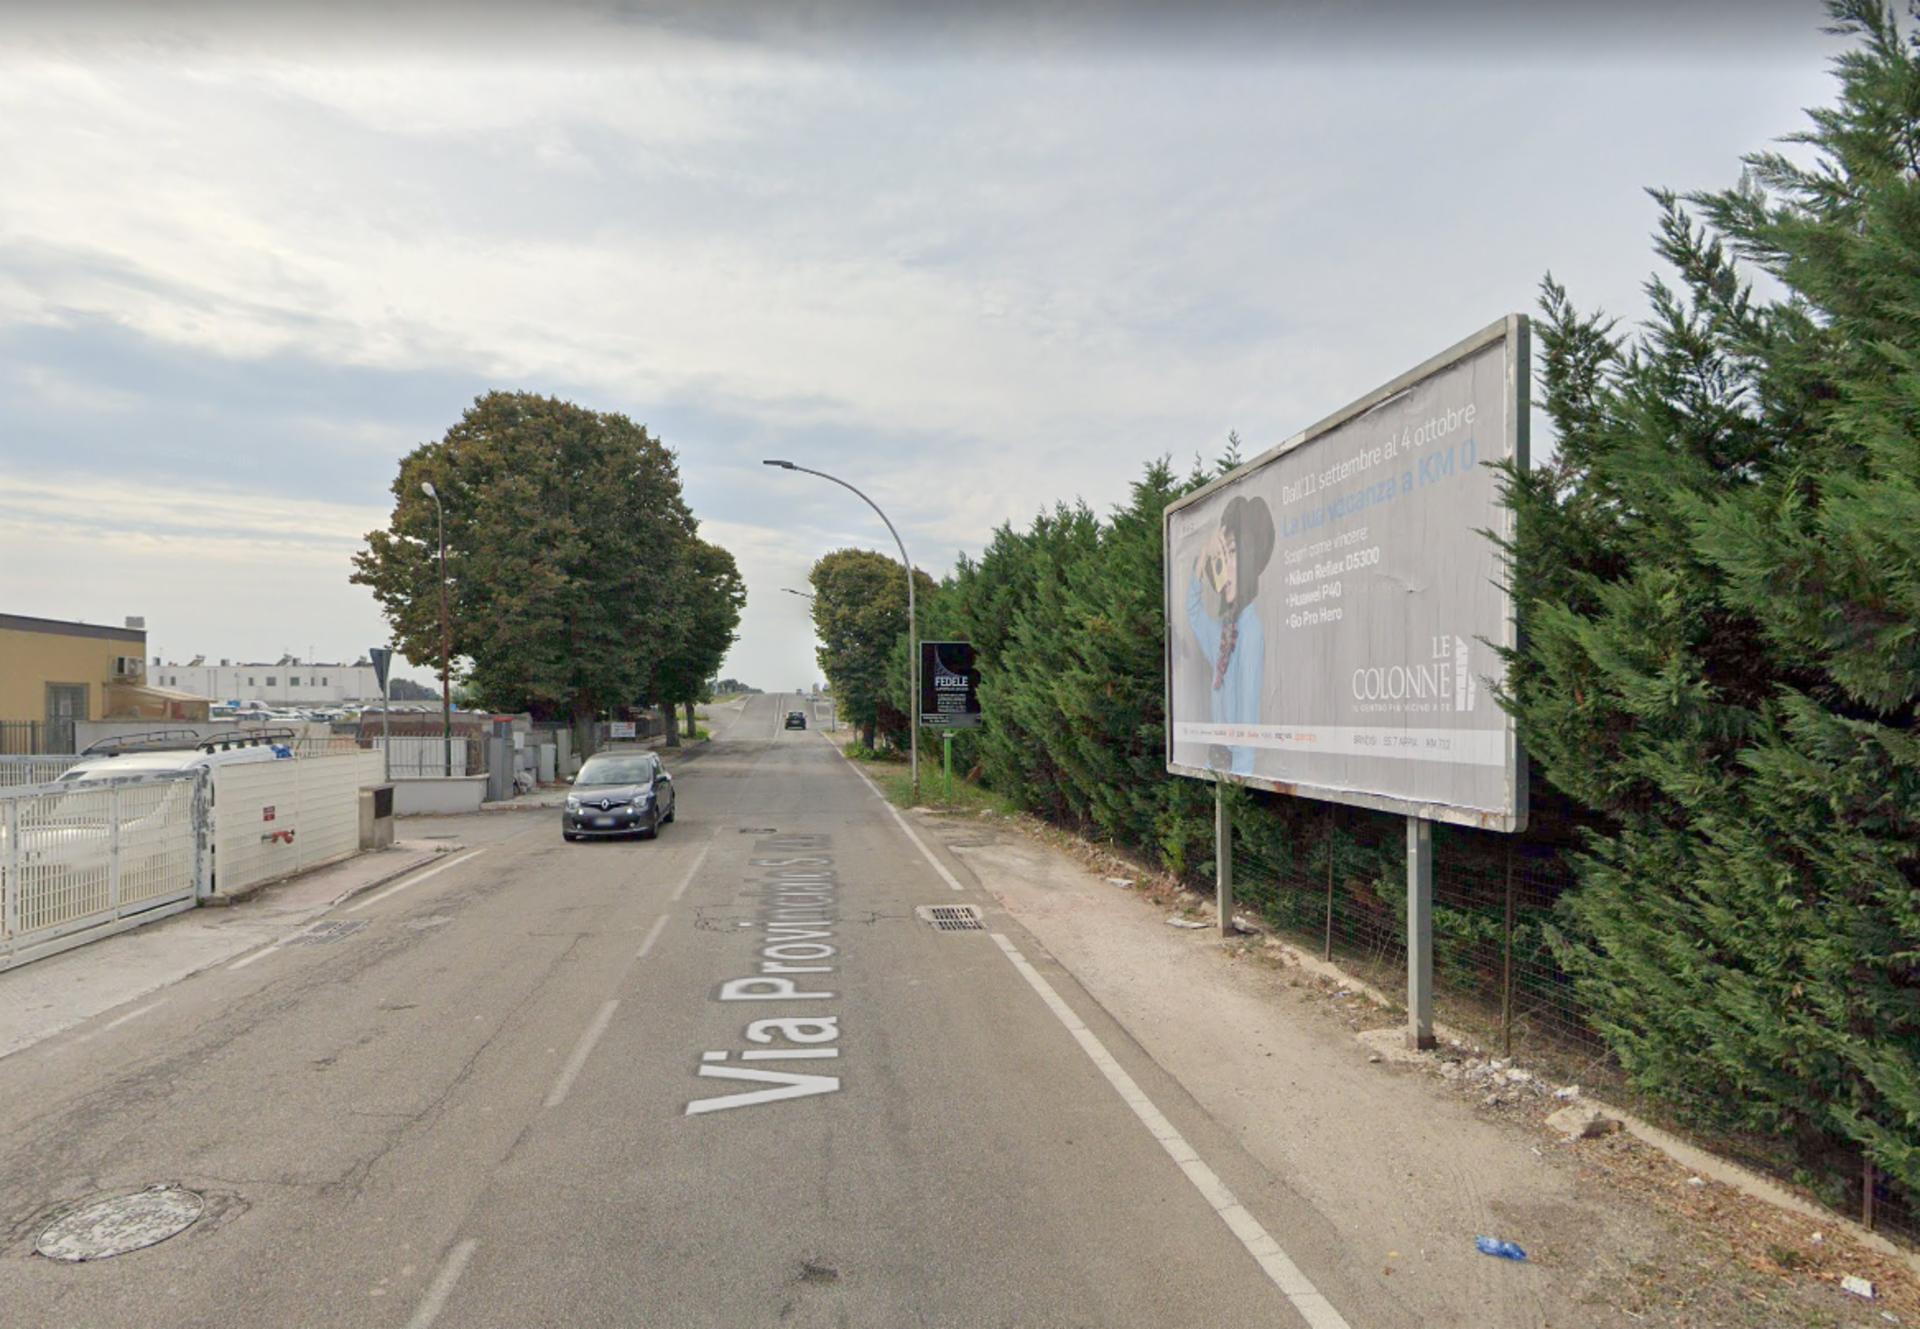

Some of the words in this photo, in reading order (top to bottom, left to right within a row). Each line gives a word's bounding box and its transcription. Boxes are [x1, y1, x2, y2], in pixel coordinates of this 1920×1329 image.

[1319, 447, 1381, 490] settembre
[1384, 434, 1398, 461] al
[1401, 426, 1411, 450] 4
[1414, 403, 1476, 446] ottobre
[1280, 514, 1298, 538] La
[1403, 470, 1414, 496] a
[1418, 447, 1456, 488] KM
[1309, 539, 1332, 557] come
[1289, 569, 1314, 586] Nikon
[1315, 560, 1344, 580] Reflex
[1345, 546, 1380, 571] D5300
[1289, 585, 1320, 607] Huawei
[1322, 581, 1341, 600] P40
[1290, 613, 1302, 628] Go
[1303, 610, 1318, 625] Pro
[1320, 606, 1342, 623] Hero
[1431, 635, 1451, 659] LE
[935, 676, 969, 687] FEDELE
[1352, 662, 1451, 701] COLONNE
